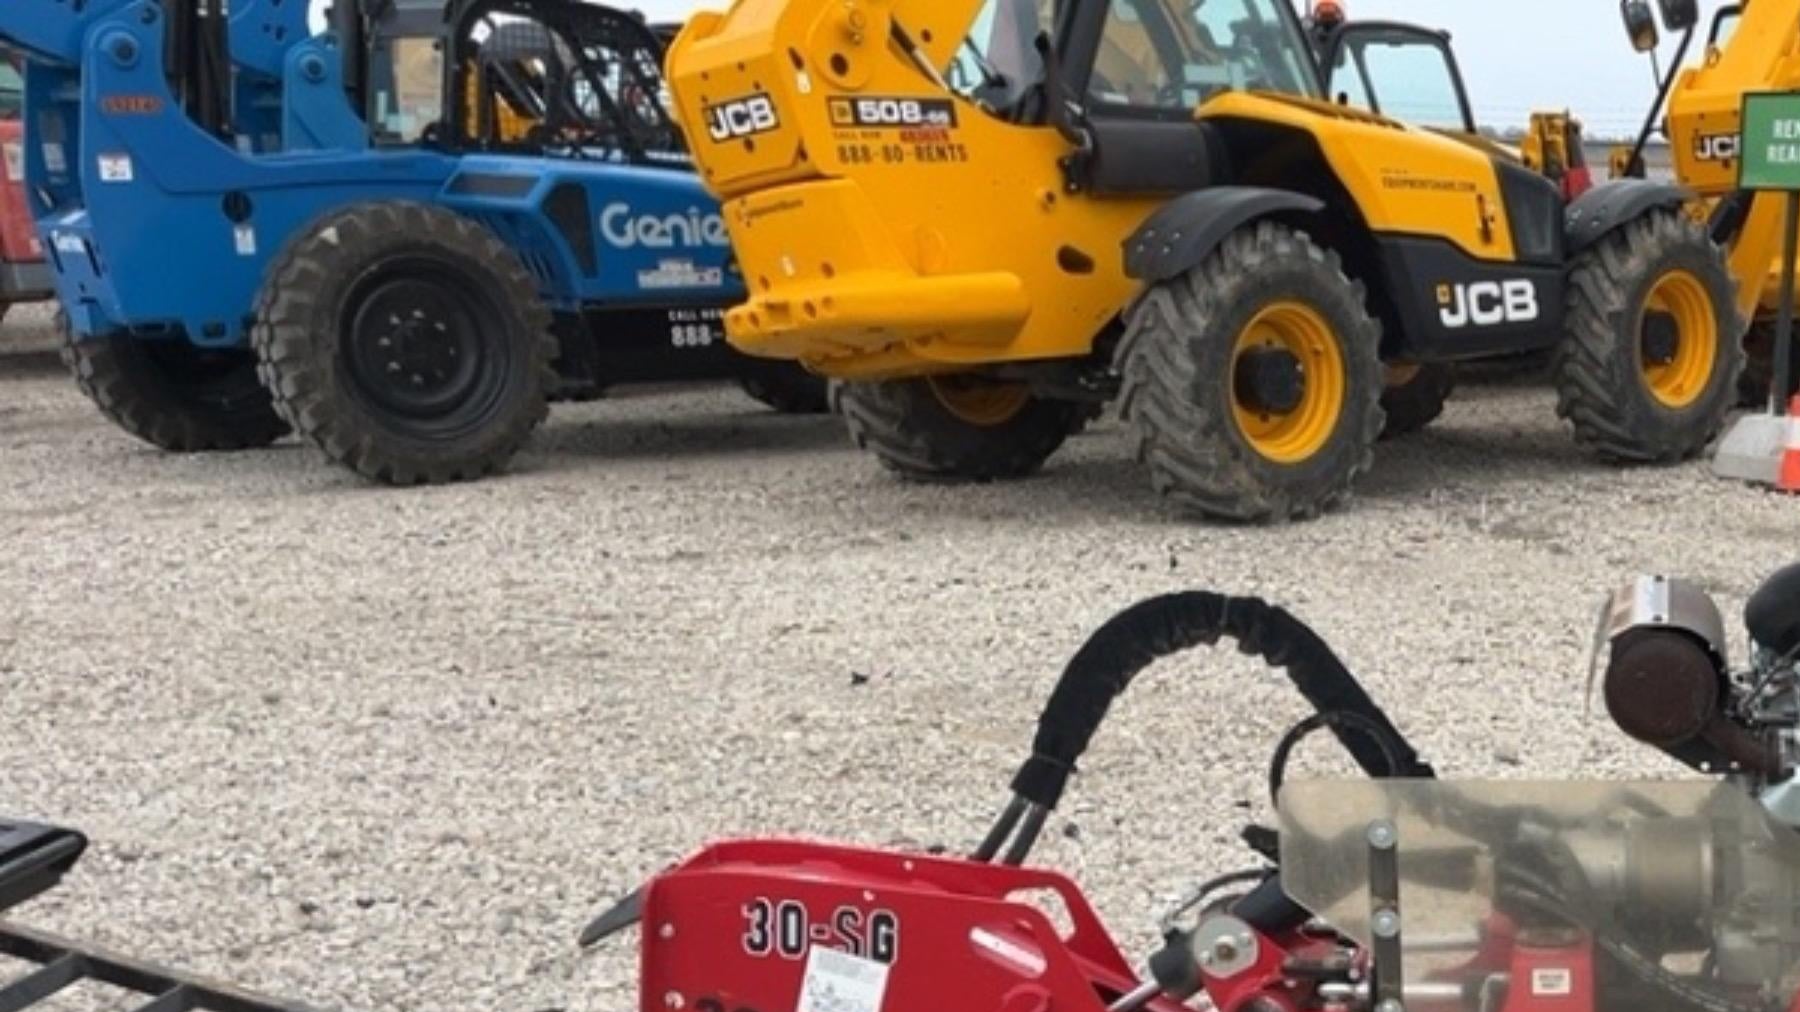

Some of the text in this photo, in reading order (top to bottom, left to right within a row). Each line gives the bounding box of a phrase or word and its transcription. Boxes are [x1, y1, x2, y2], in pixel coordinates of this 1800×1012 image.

[711, 97, 778, 140] JCB
[1696, 134, 1740, 160] JC
[600, 202, 730, 248] Genie
[1437, 278, 1538, 328] JCB
[742, 896, 898, 964] 30-SG
